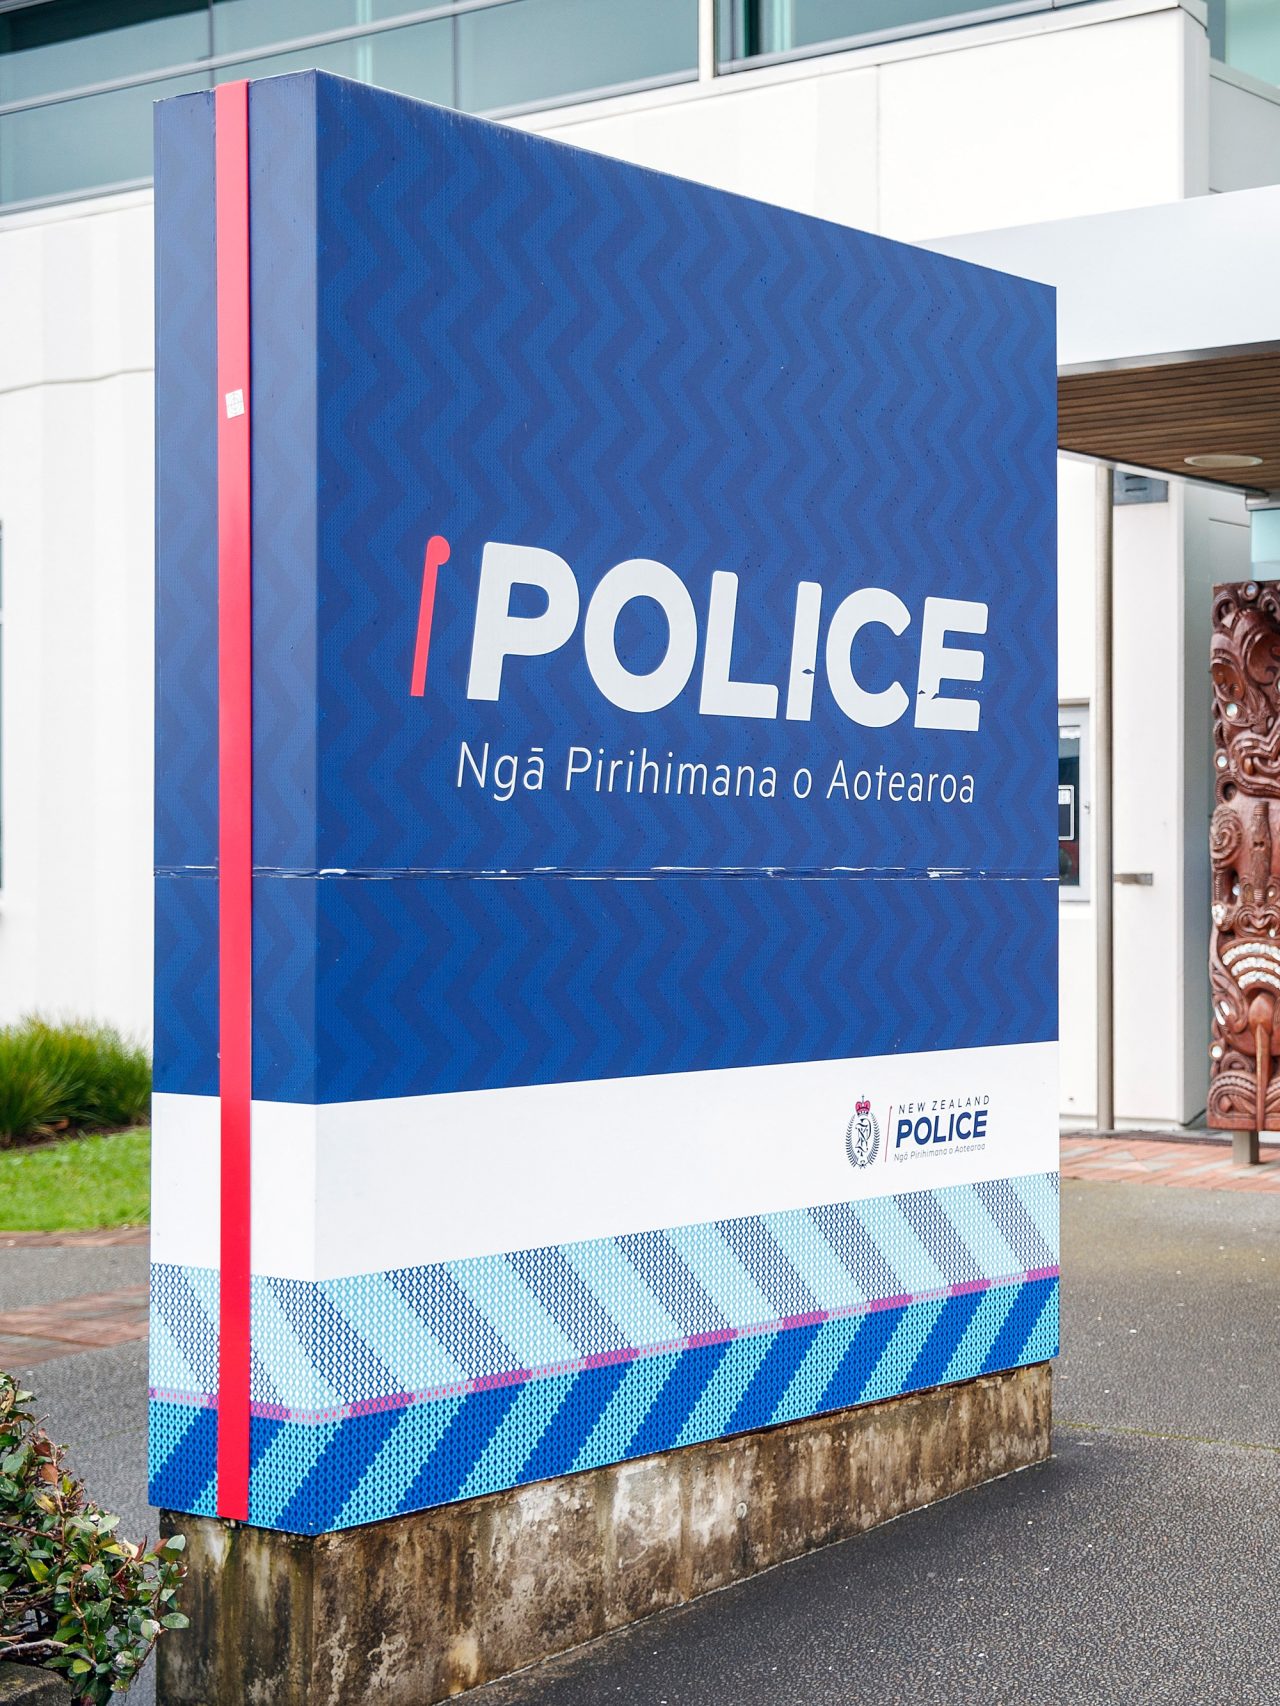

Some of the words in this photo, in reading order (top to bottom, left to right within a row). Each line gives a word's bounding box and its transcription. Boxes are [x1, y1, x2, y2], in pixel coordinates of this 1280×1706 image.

[466, 541, 989, 731] POLICE
[457, 741, 545, 801] Ngā
[565, 746, 777, 798] Pirihimana
[793, 768, 812, 799] o
[826, 759, 975, 803] Aotearoa
[898, 1102, 926, 1114] NEW
[931, 1095, 990, 1111] ZEALAND
[896, 1110, 988, 1148] POLICE
[910, 1148, 948, 1160] Pirihimana
